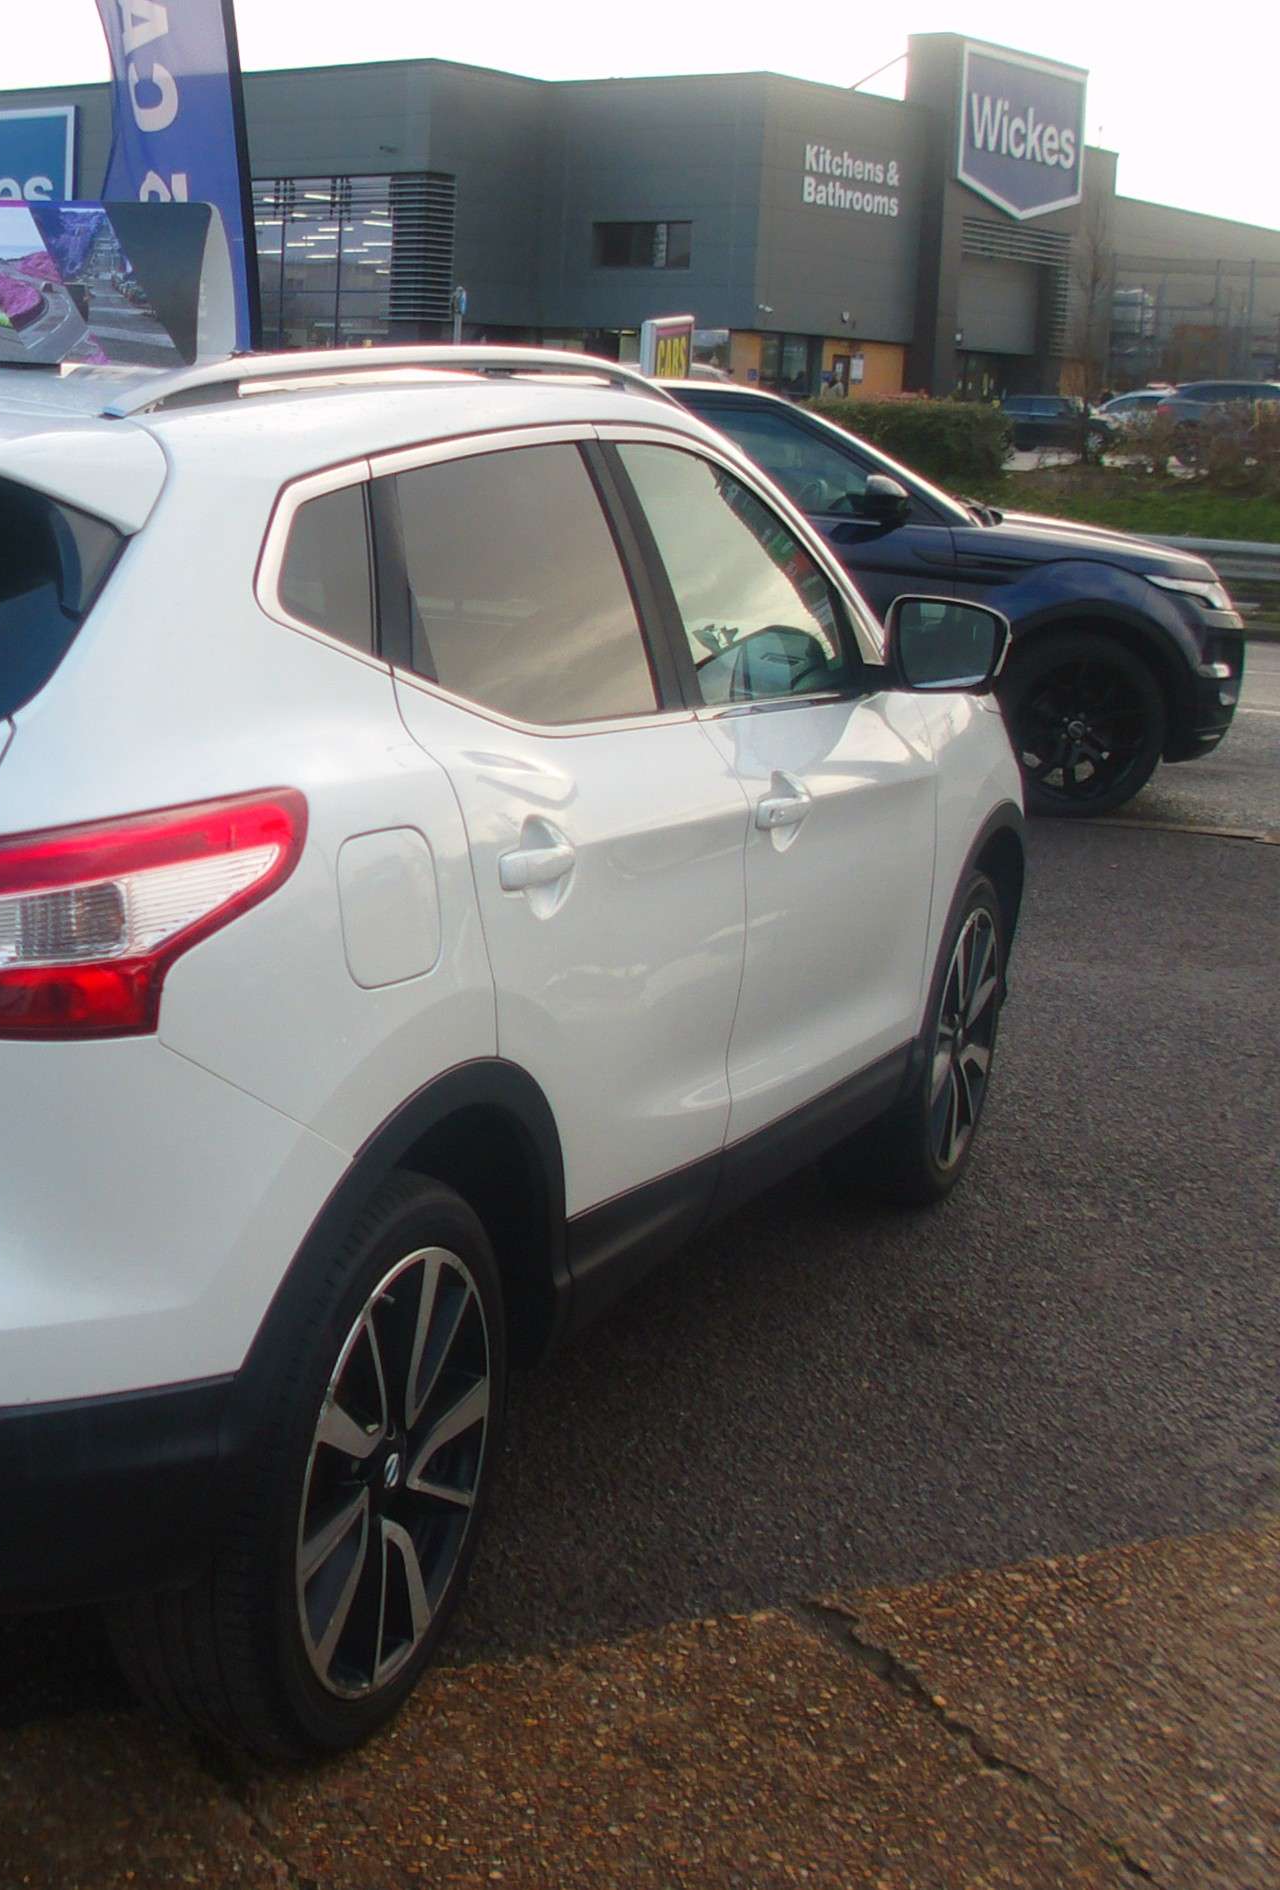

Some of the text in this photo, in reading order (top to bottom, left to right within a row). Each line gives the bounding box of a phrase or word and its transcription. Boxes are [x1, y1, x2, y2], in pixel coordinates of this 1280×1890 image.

[970, 92, 1076, 170] Wickes
[804, 144, 900, 187] Kitchens &
[802, 176, 899, 217] Bathrooms
